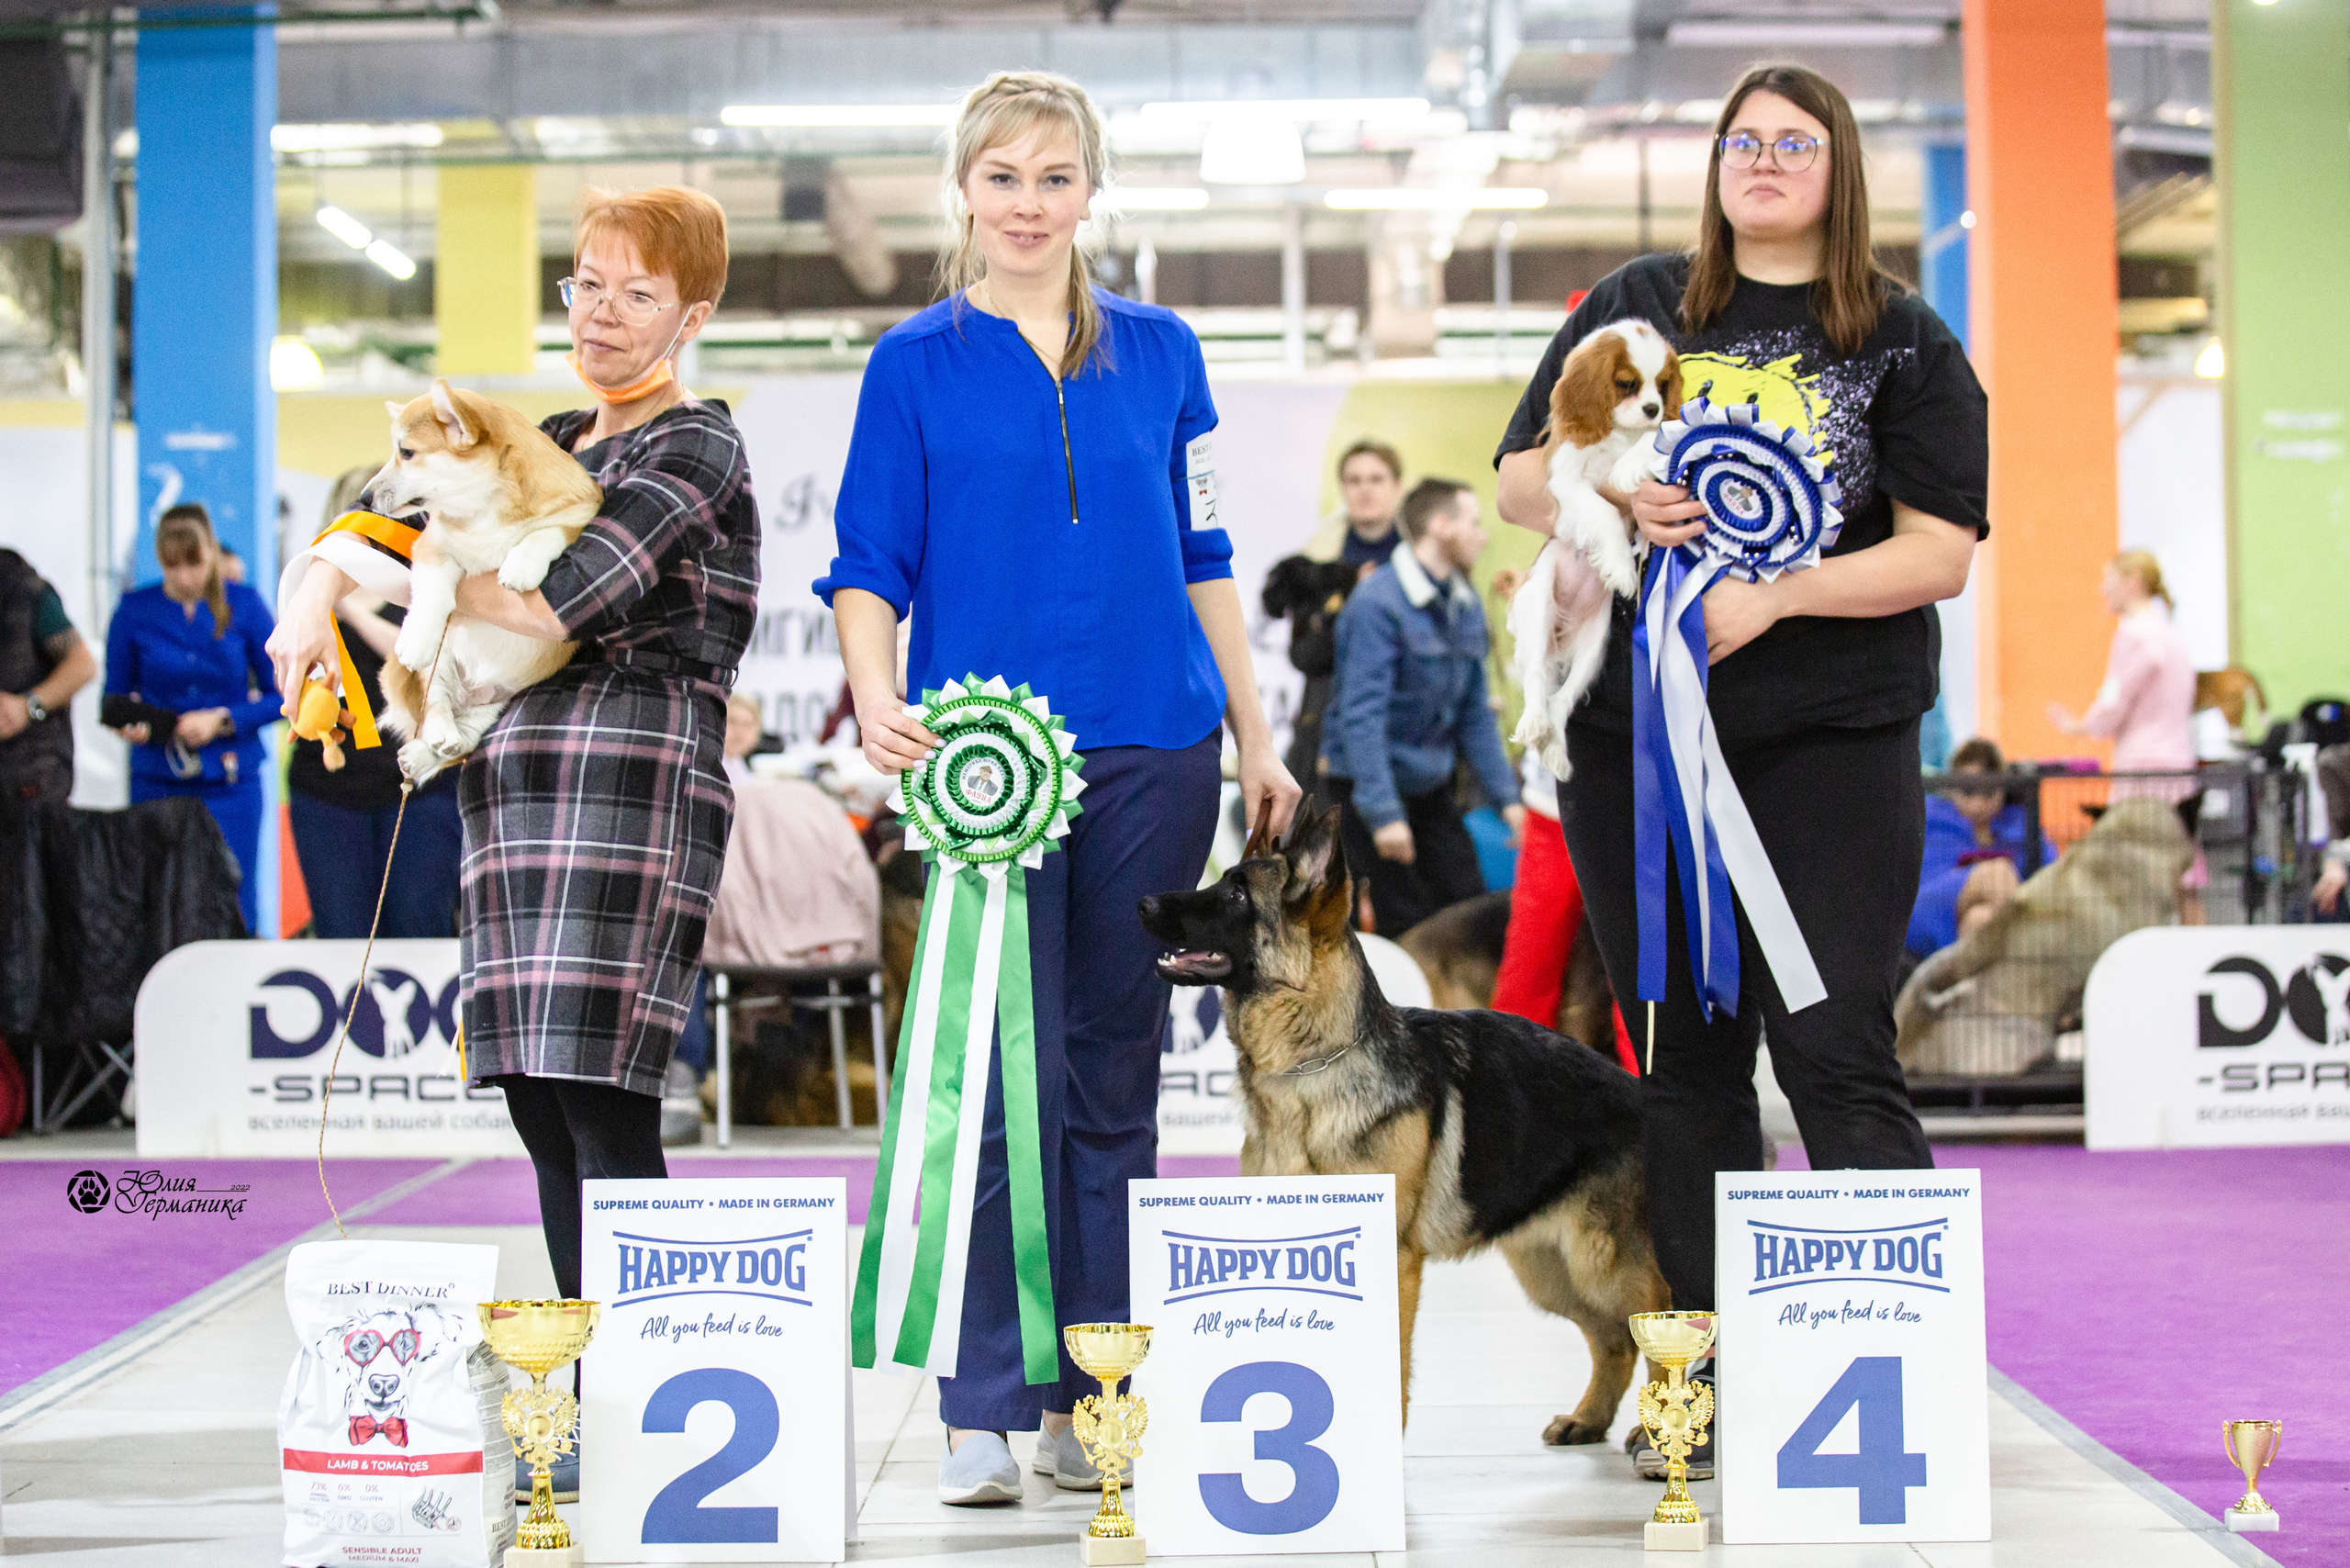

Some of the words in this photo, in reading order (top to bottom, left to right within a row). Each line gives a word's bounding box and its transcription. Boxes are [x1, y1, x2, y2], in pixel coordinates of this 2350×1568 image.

[966, 789, 991, 804] ФАУНА
[1139, 1197, 1196, 1207] SUPREME
[1199, 1196, 1252, 1206] QUALITY
[1267, 1195, 1303, 1204] MADE
[1305, 1194, 1319, 1204] IN
[1322, 1193, 1385, 1204] GERMANY
[1728, 1190, 1784, 1200] SUPREME
[1786, 1189, 1840, 1199] QUALITY
[1853, 1189, 1888, 1198] MADE
[1892, 1188, 1906, 1198] IN
[1908, 1188, 1970, 1198] GERMANY
[593, 1200, 649, 1210] SUPREME
[652, 1199, 704, 1210] QUALITY
[718, 1199, 754, 1208] MADE
[757, 1199, 770, 1208] IN
[773, 1198, 835, 1208] GERMANY
[1753, 1232, 1868, 1282] HAPPY
[1873, 1231, 1943, 1279] DOG
[618, 1243, 732, 1294] HAPPY
[736, 1243, 806, 1292] DOG
[1168, 1242, 1281, 1292] HAPPY
[1286, 1240, 1356, 1287] DOG
[328, 1281, 373, 1295] BEST
[377, 1282, 448, 1298] DINNER
[1193, 1311, 1222, 1335] All
[1225, 1317, 1252, 1338] you
[1255, 1307, 1288, 1332] feed
[1290, 1316, 1303, 1328] is
[1307, 1309, 1335, 1330] love
[1778, 1302, 1807, 1326] All
[1810, 1309, 1839, 1329] you
[1841, 1299, 1874, 1324] feed
[1876, 1306, 1890, 1320] is
[1894, 1301, 1922, 1323] love
[640, 1315, 669, 1339] All
[672, 1321, 699, 1343] you
[703, 1313, 736, 1338] feed
[738, 1320, 752, 1334] is
[755, 1315, 783, 1337] love
[1197, 1361, 1340, 1537] 3
[1776, 1356, 1928, 1525] 4
[641, 1368, 780, 1544] 2
[327, 1460, 359, 1470] LAMB
[361, 1461, 369, 1470] &
[371, 1461, 429, 1472] TOMATOES
[310, 1482, 328, 1491] 73%
[338, 1484, 351, 1492] 0%
[365, 1484, 378, 1493] 0%
[342, 1546, 387, 1554] SENSIBLE
[390, 1547, 422, 1555] ADULT
